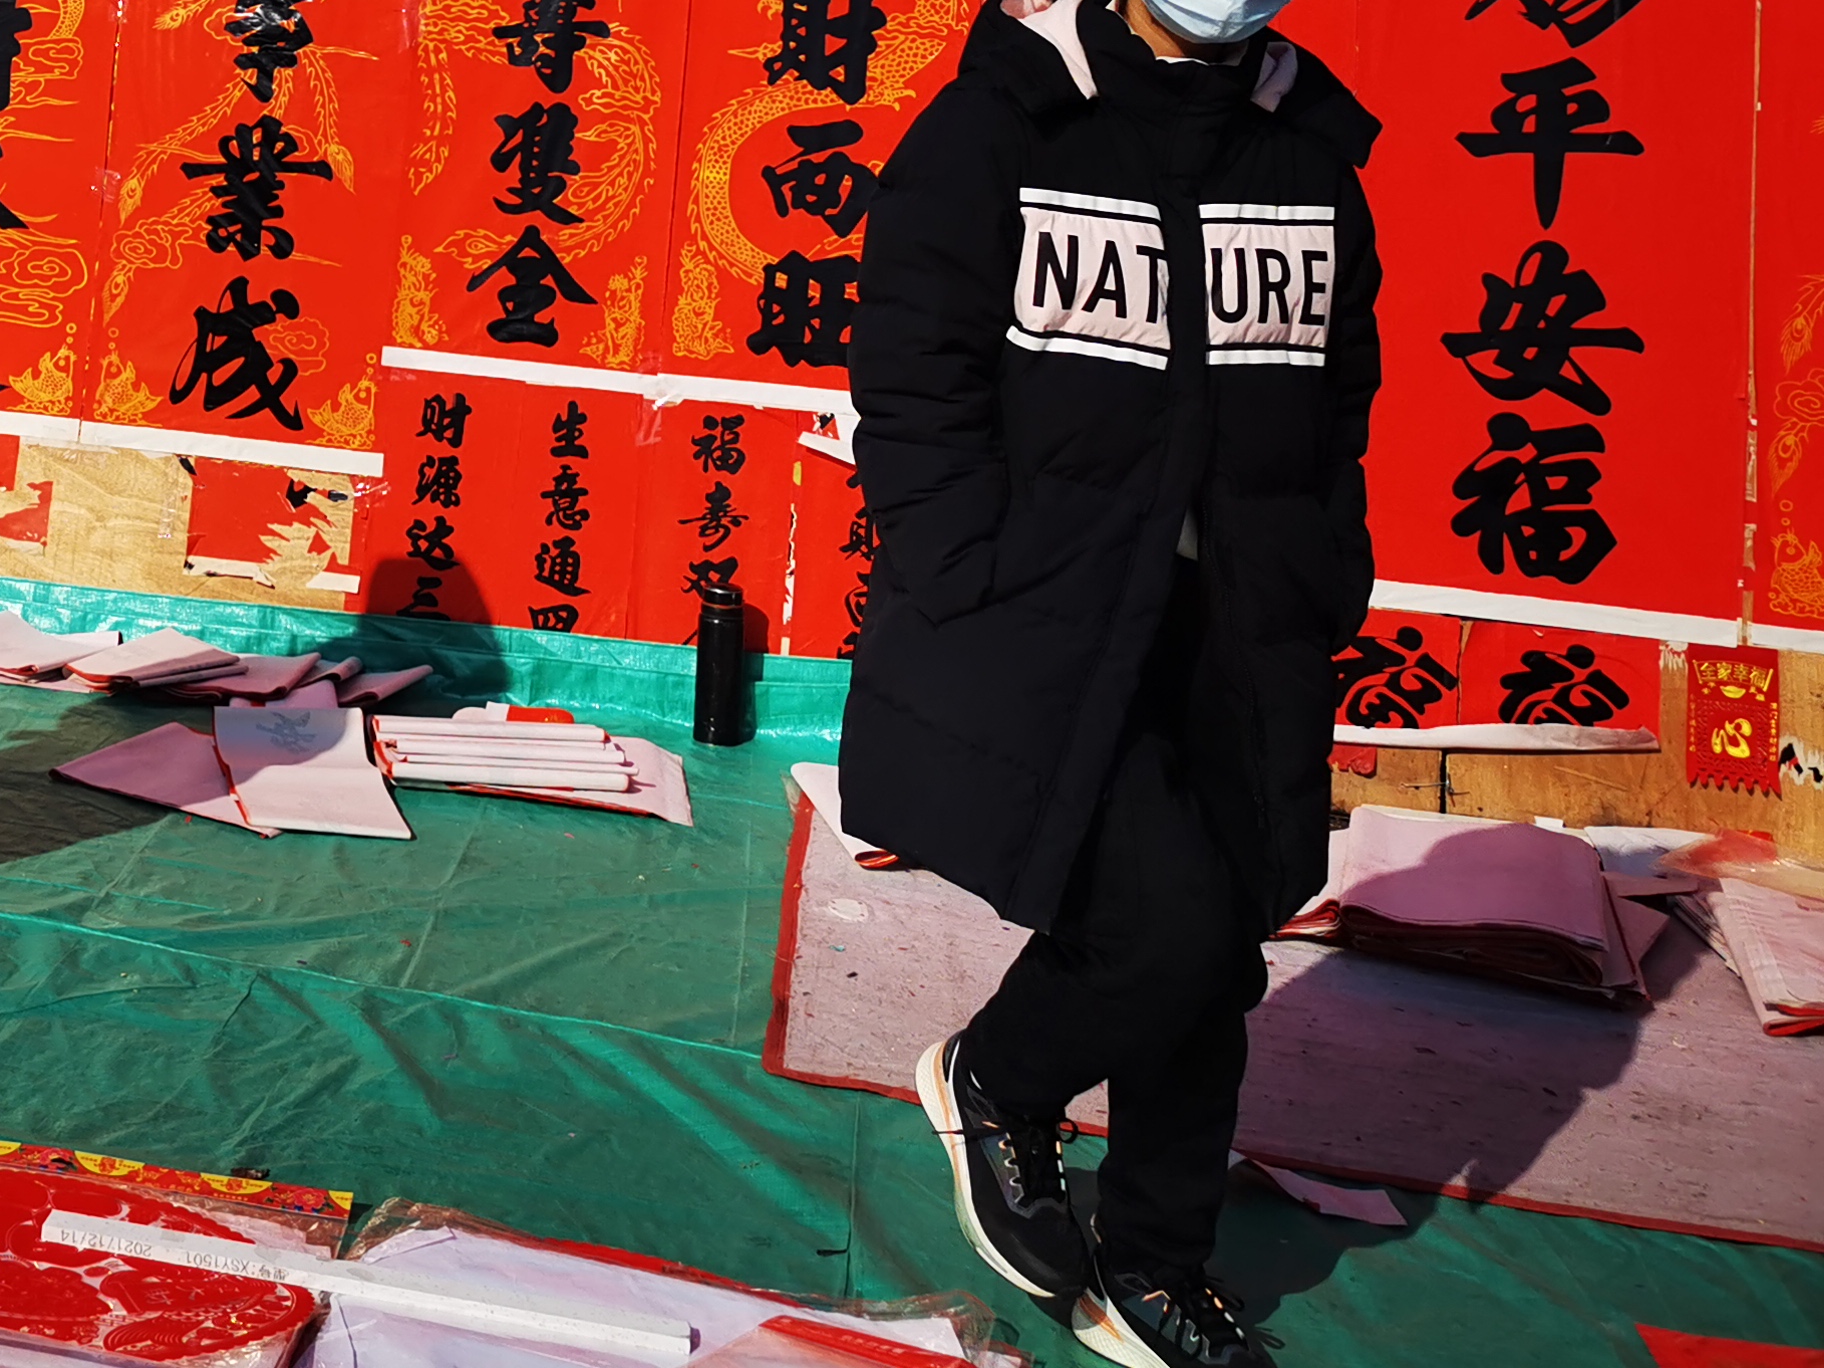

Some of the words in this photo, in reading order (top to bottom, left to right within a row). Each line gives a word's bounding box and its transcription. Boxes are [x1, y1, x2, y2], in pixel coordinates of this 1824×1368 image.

[1032, 230, 1329, 327] NATURE
[1699, 661, 1768, 689] 全家幸福
[61, 1229, 152, 1257] 2021/12/14
